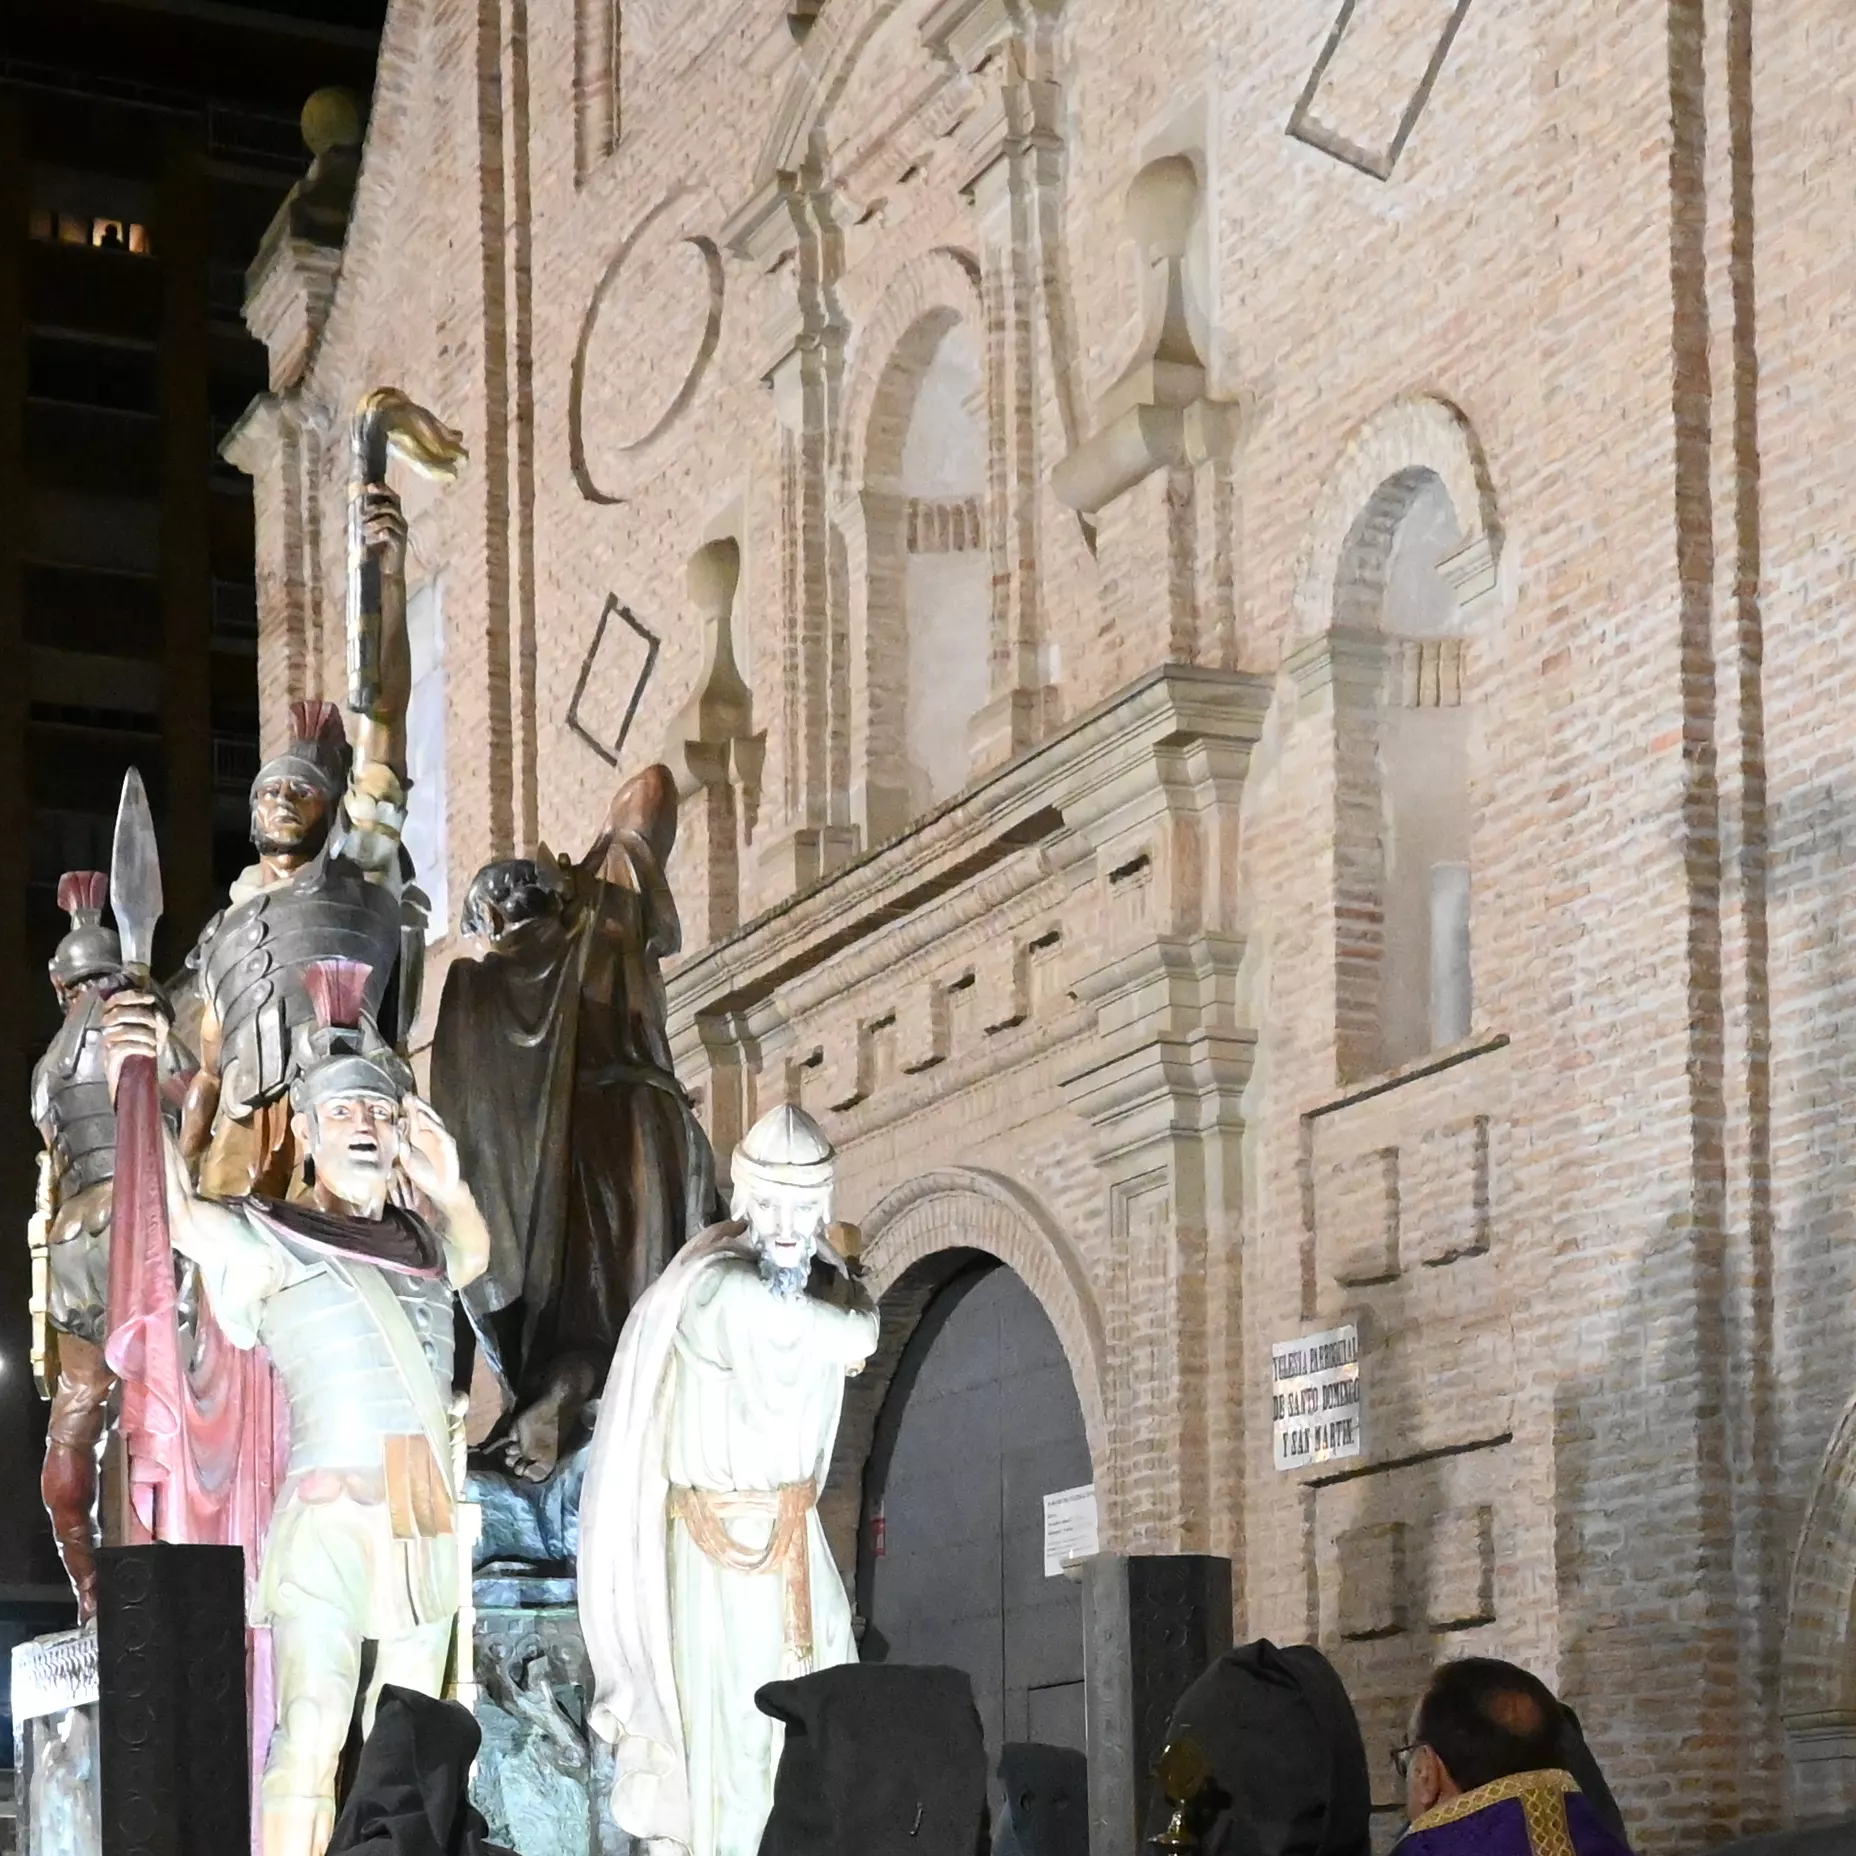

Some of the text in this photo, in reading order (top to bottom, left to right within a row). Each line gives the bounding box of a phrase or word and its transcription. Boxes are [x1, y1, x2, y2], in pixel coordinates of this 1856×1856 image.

[1272, 1377, 1360, 1421] DE SANTO DOMINGO
[1282, 1432, 1289, 1458] Y
[1291, 1427, 1310, 1456] SAN
